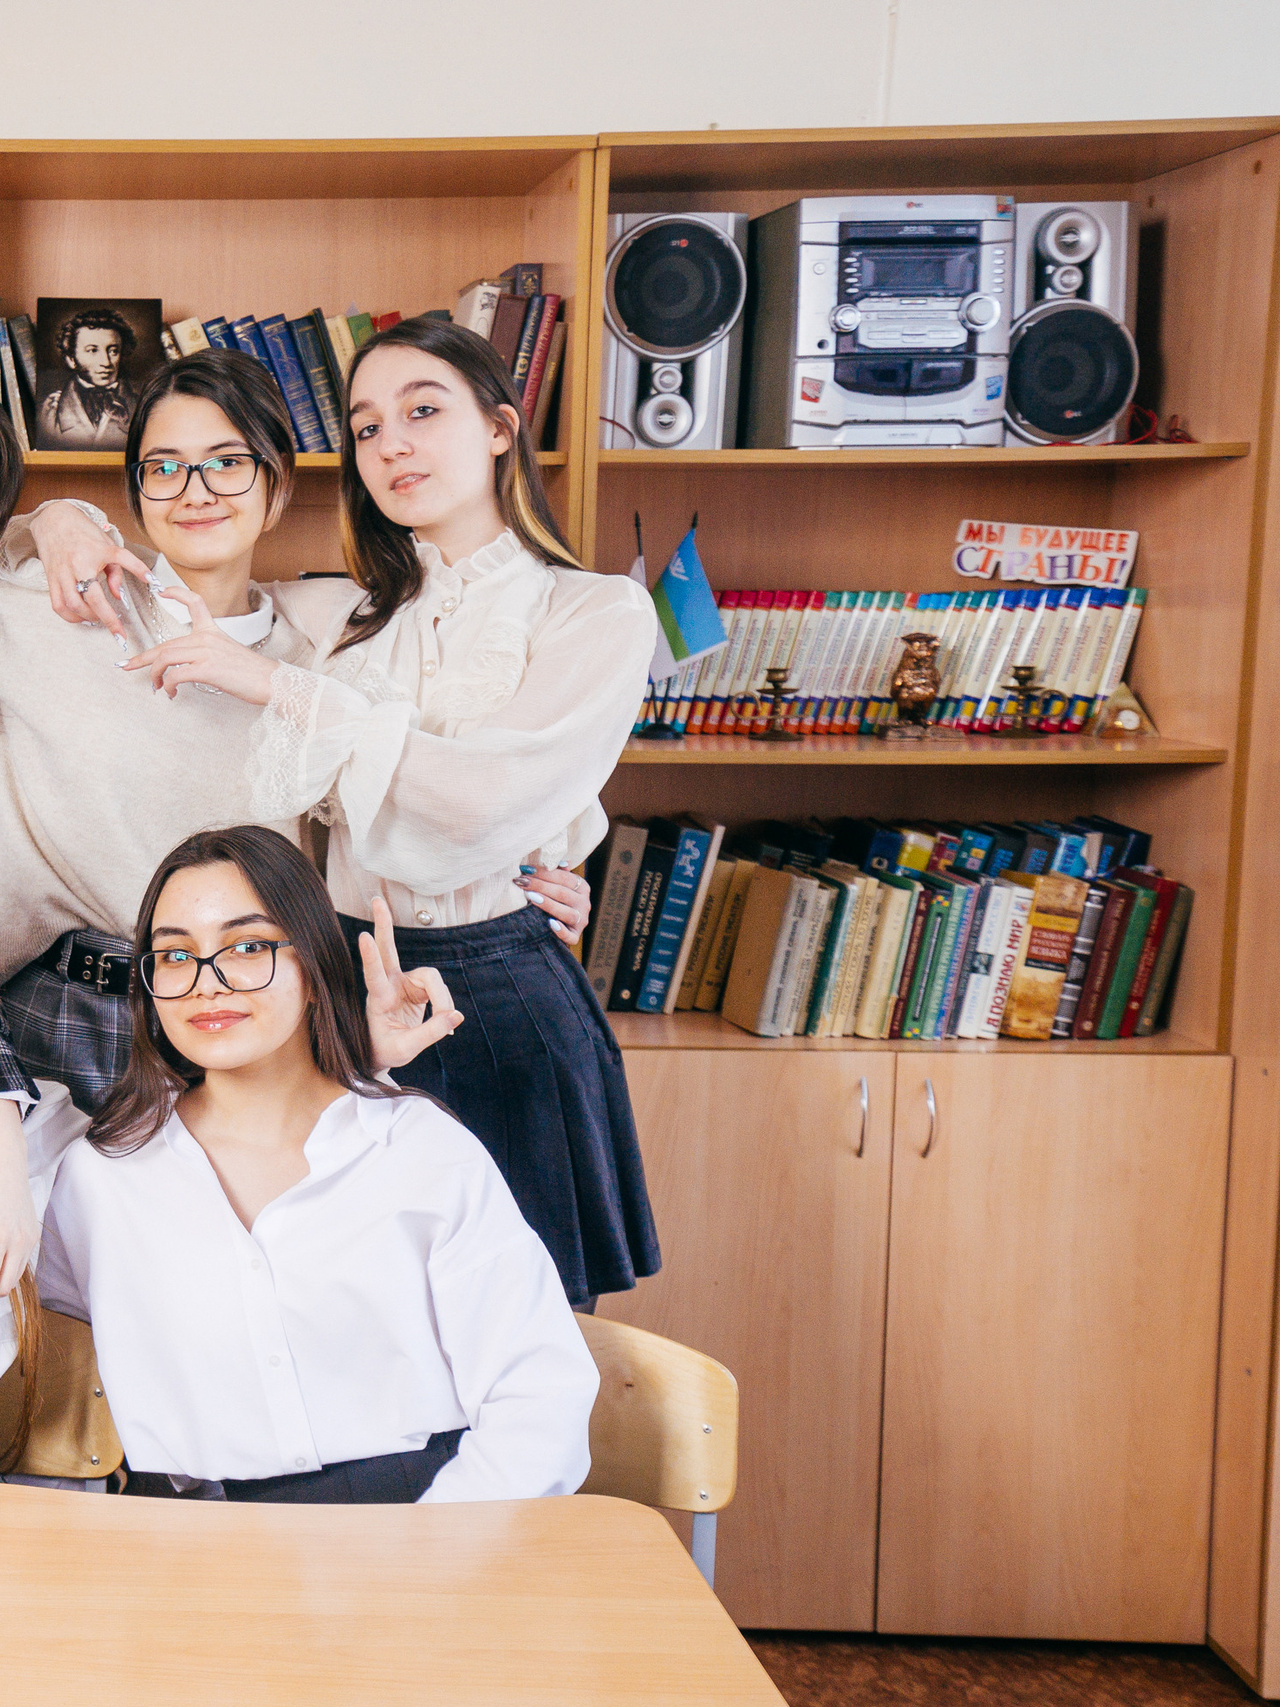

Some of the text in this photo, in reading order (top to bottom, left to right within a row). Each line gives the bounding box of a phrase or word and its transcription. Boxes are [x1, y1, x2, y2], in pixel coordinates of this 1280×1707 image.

[964, 522, 1130, 553] МЫ БУДУЩЕЕ
[956, 546, 1128, 584] СТРАНЫ!
[630, 910, 643, 937] ЯЗЫКА
[631, 937, 647, 972] СЛОВАРЬ
[987, 918, 1024, 1028] Я ПОЗНАЮ МИР
